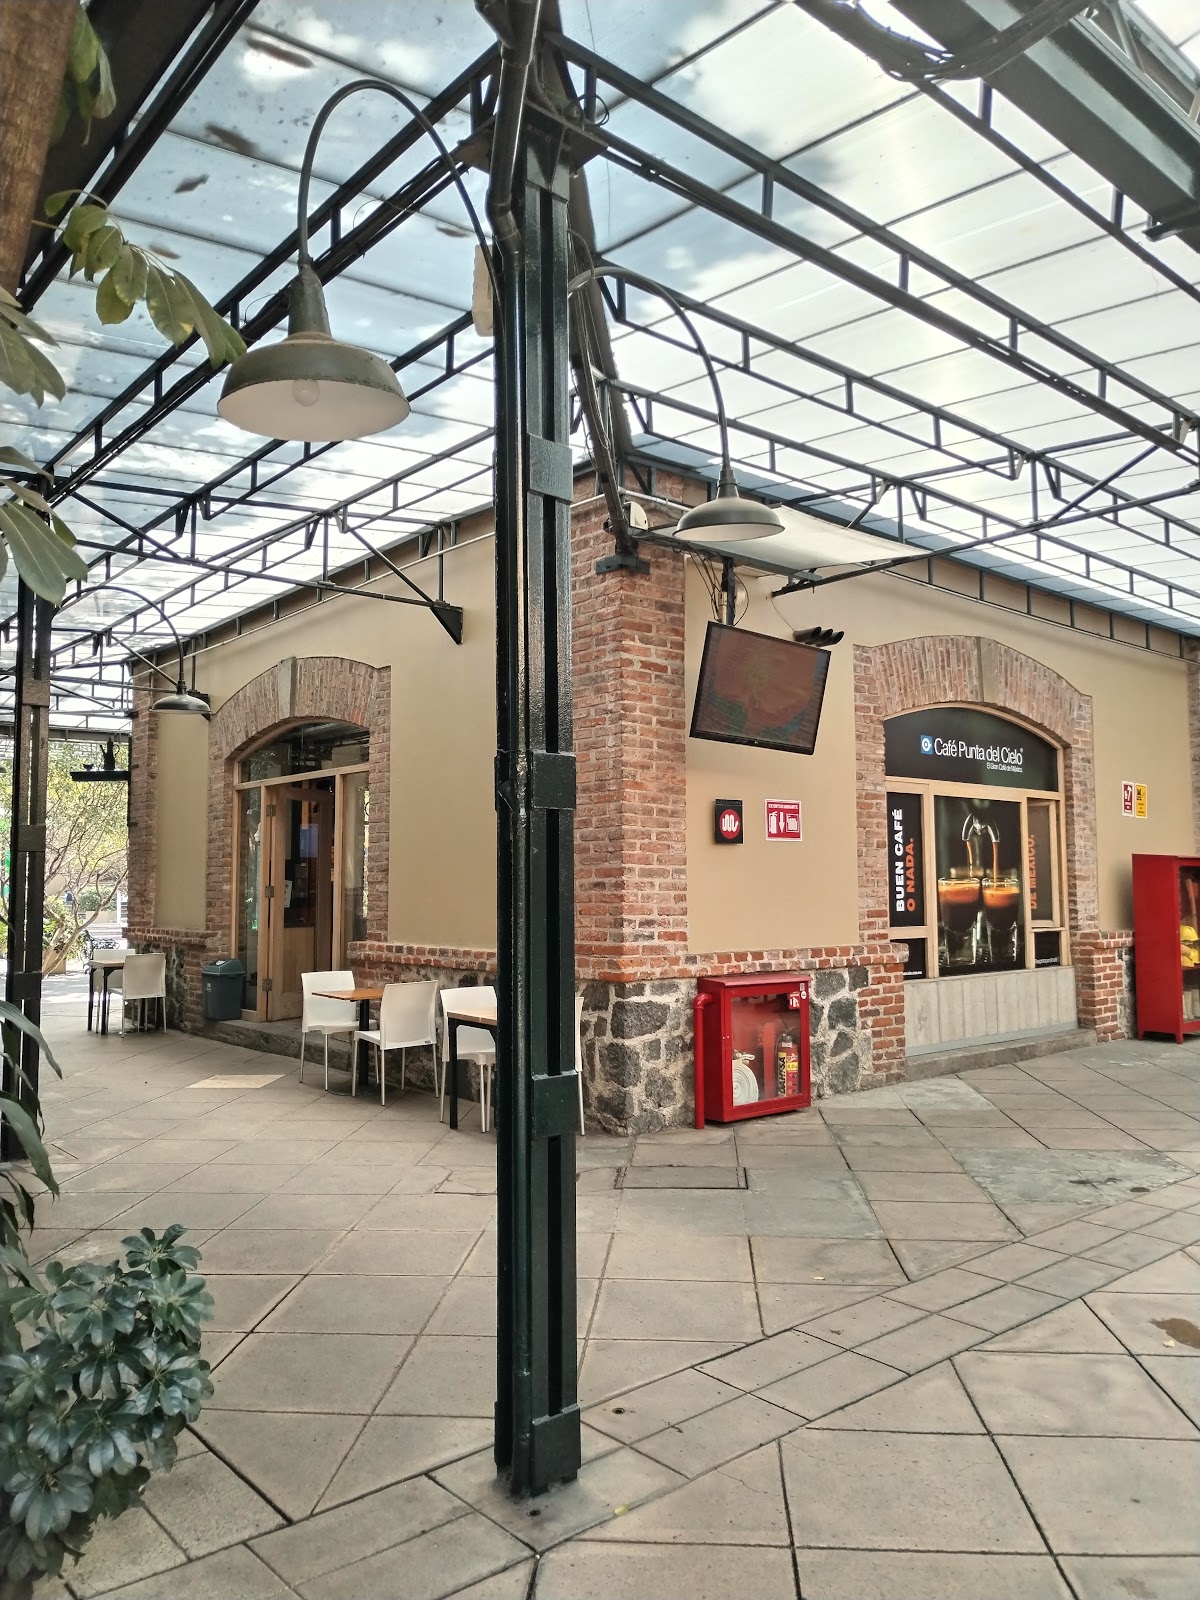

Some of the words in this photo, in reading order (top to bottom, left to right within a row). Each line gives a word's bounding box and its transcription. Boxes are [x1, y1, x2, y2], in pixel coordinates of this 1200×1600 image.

[934, 738, 957, 757] Café
[959, 741, 985, 761] Punta
[986, 746, 1000, 762] del
[1001, 747, 1023, 765] Cielo
[892, 809, 903, 857] CAFÉ
[895, 861, 905, 912] BUEN
[905, 837, 915, 893] NADA.
[906, 898, 915, 912] O
